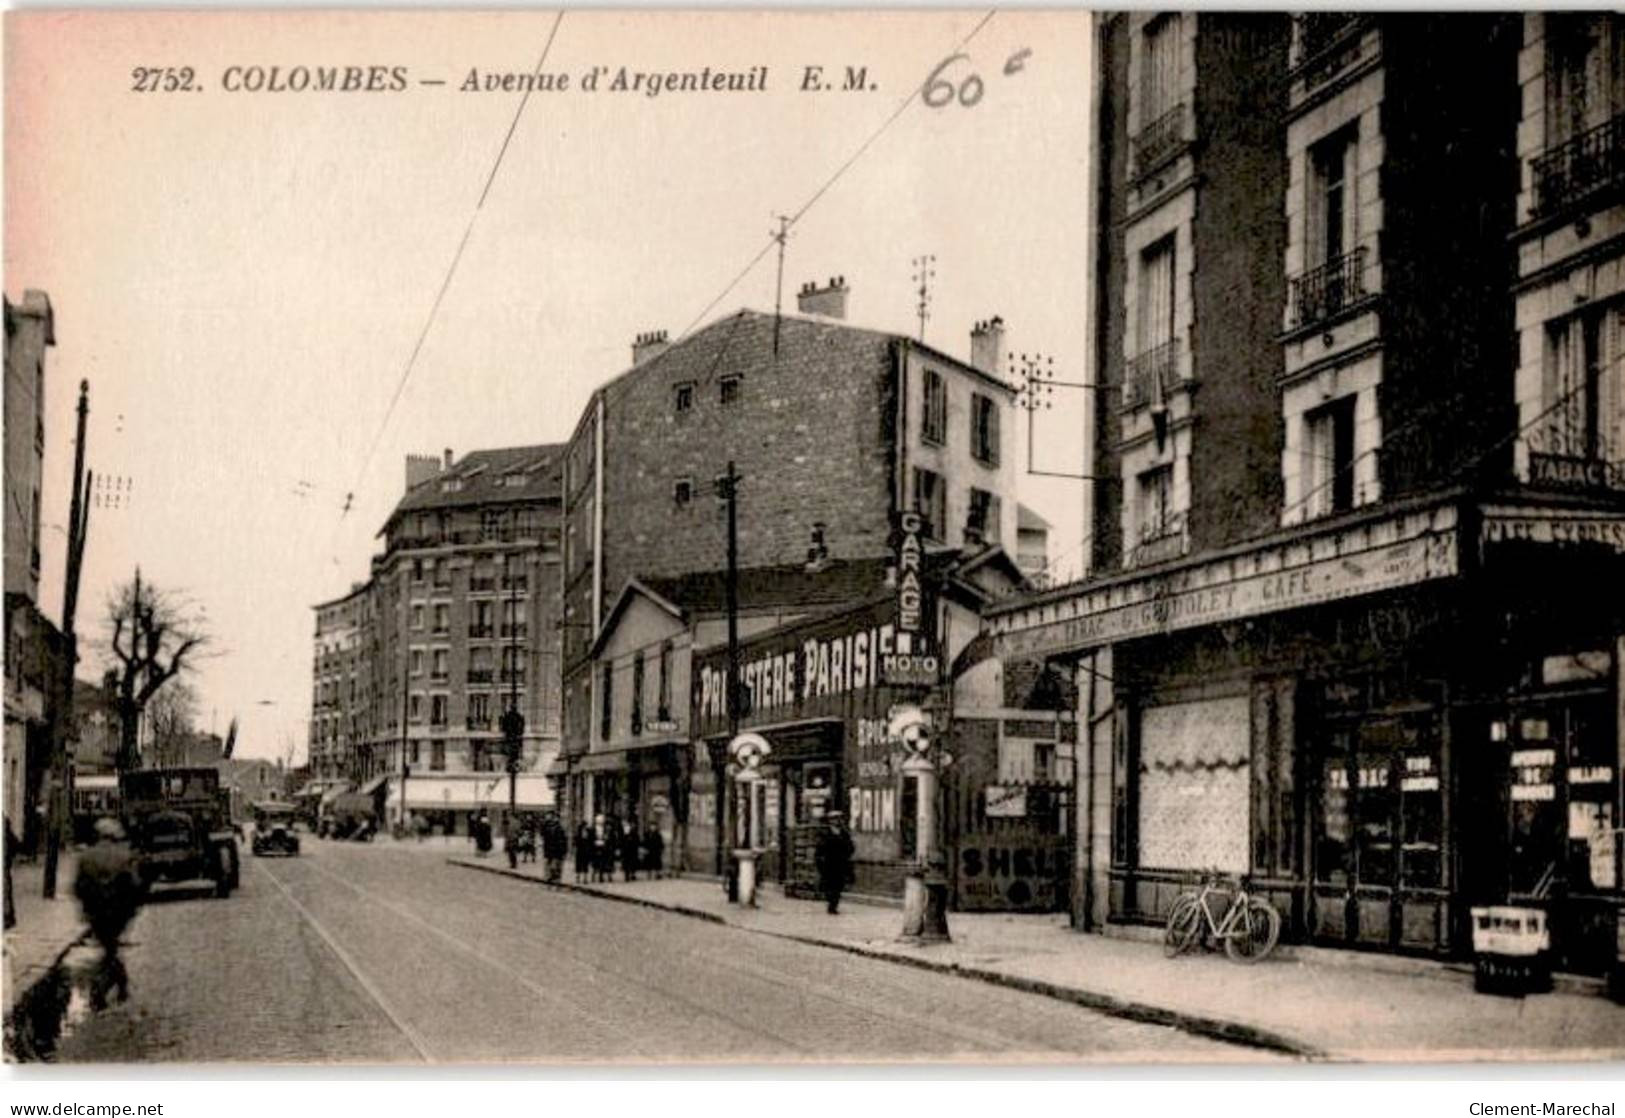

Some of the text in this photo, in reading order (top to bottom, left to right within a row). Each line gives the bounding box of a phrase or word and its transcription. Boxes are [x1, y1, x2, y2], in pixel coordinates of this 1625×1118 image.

[922, 52, 985, 108] 60
[1531, 458, 1602, 486] TABAC
[901, 512, 921, 631] GARAGE
[884, 656, 938, 673] MOTO
